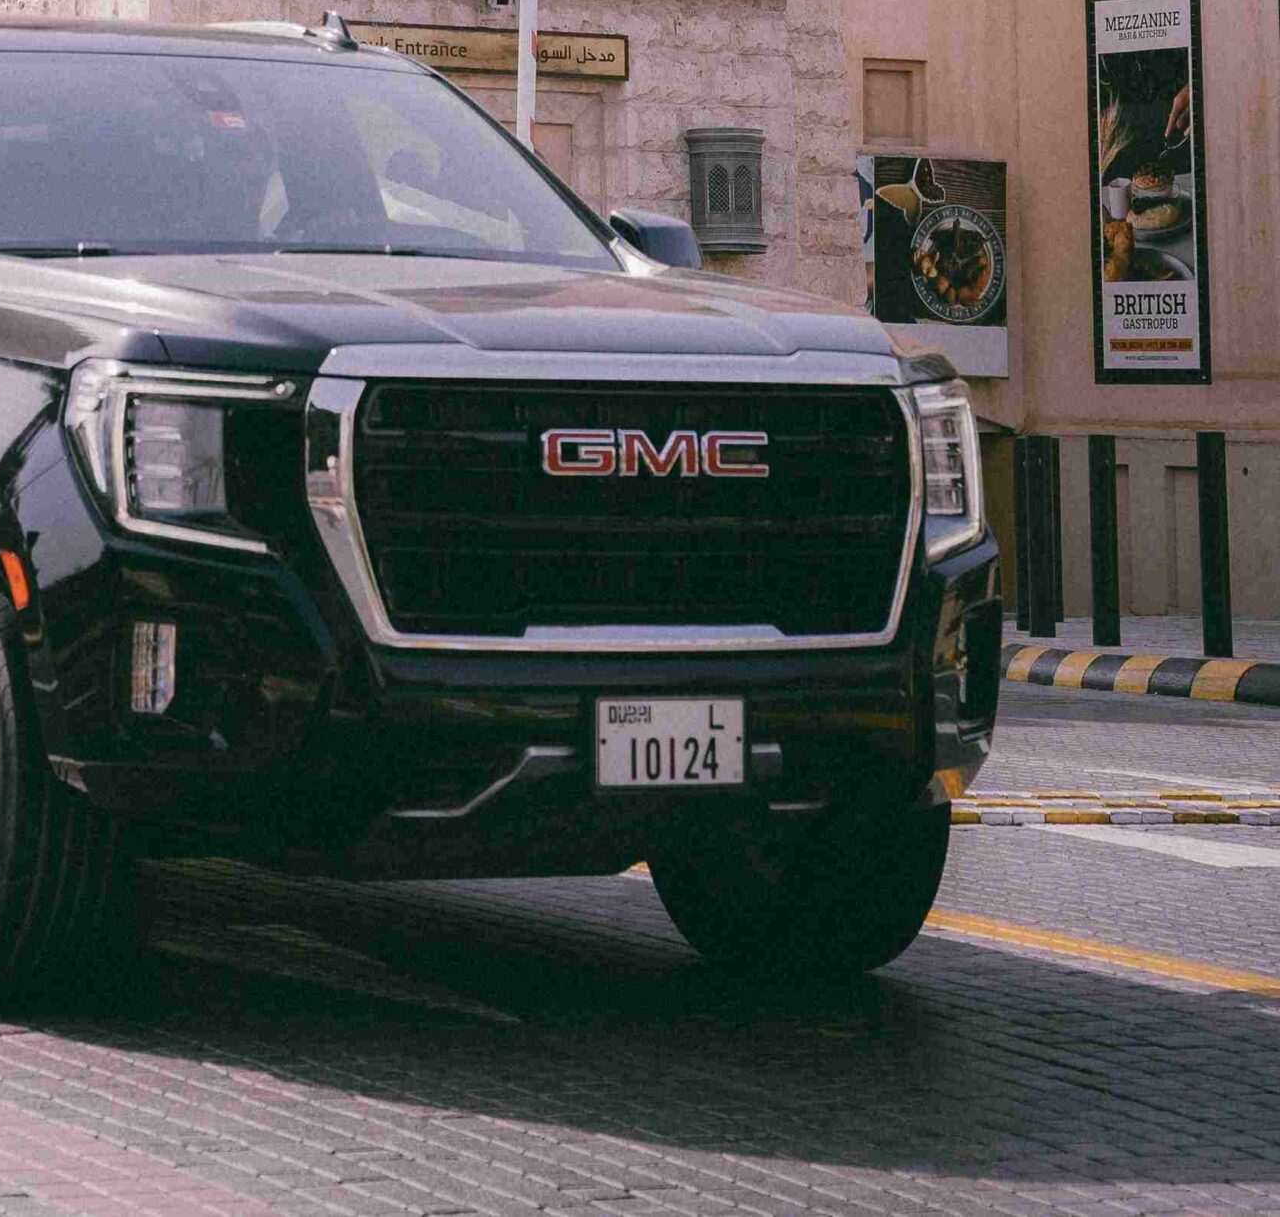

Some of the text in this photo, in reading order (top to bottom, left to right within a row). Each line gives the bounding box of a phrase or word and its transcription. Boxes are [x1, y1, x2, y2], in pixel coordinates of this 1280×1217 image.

[1104, 10, 1181, 32] MEZZANINE
[395, 38, 467, 58] Entrance
[536, 44, 616, 64] مدخل السو
[1114, 293, 1187, 316] BRITISH
[1122, 318, 1180, 330] GASTROPUB
[541, 429, 769, 477] GMC
[709, 704, 725, 730] L
[631, 737, 719, 780] 10124
